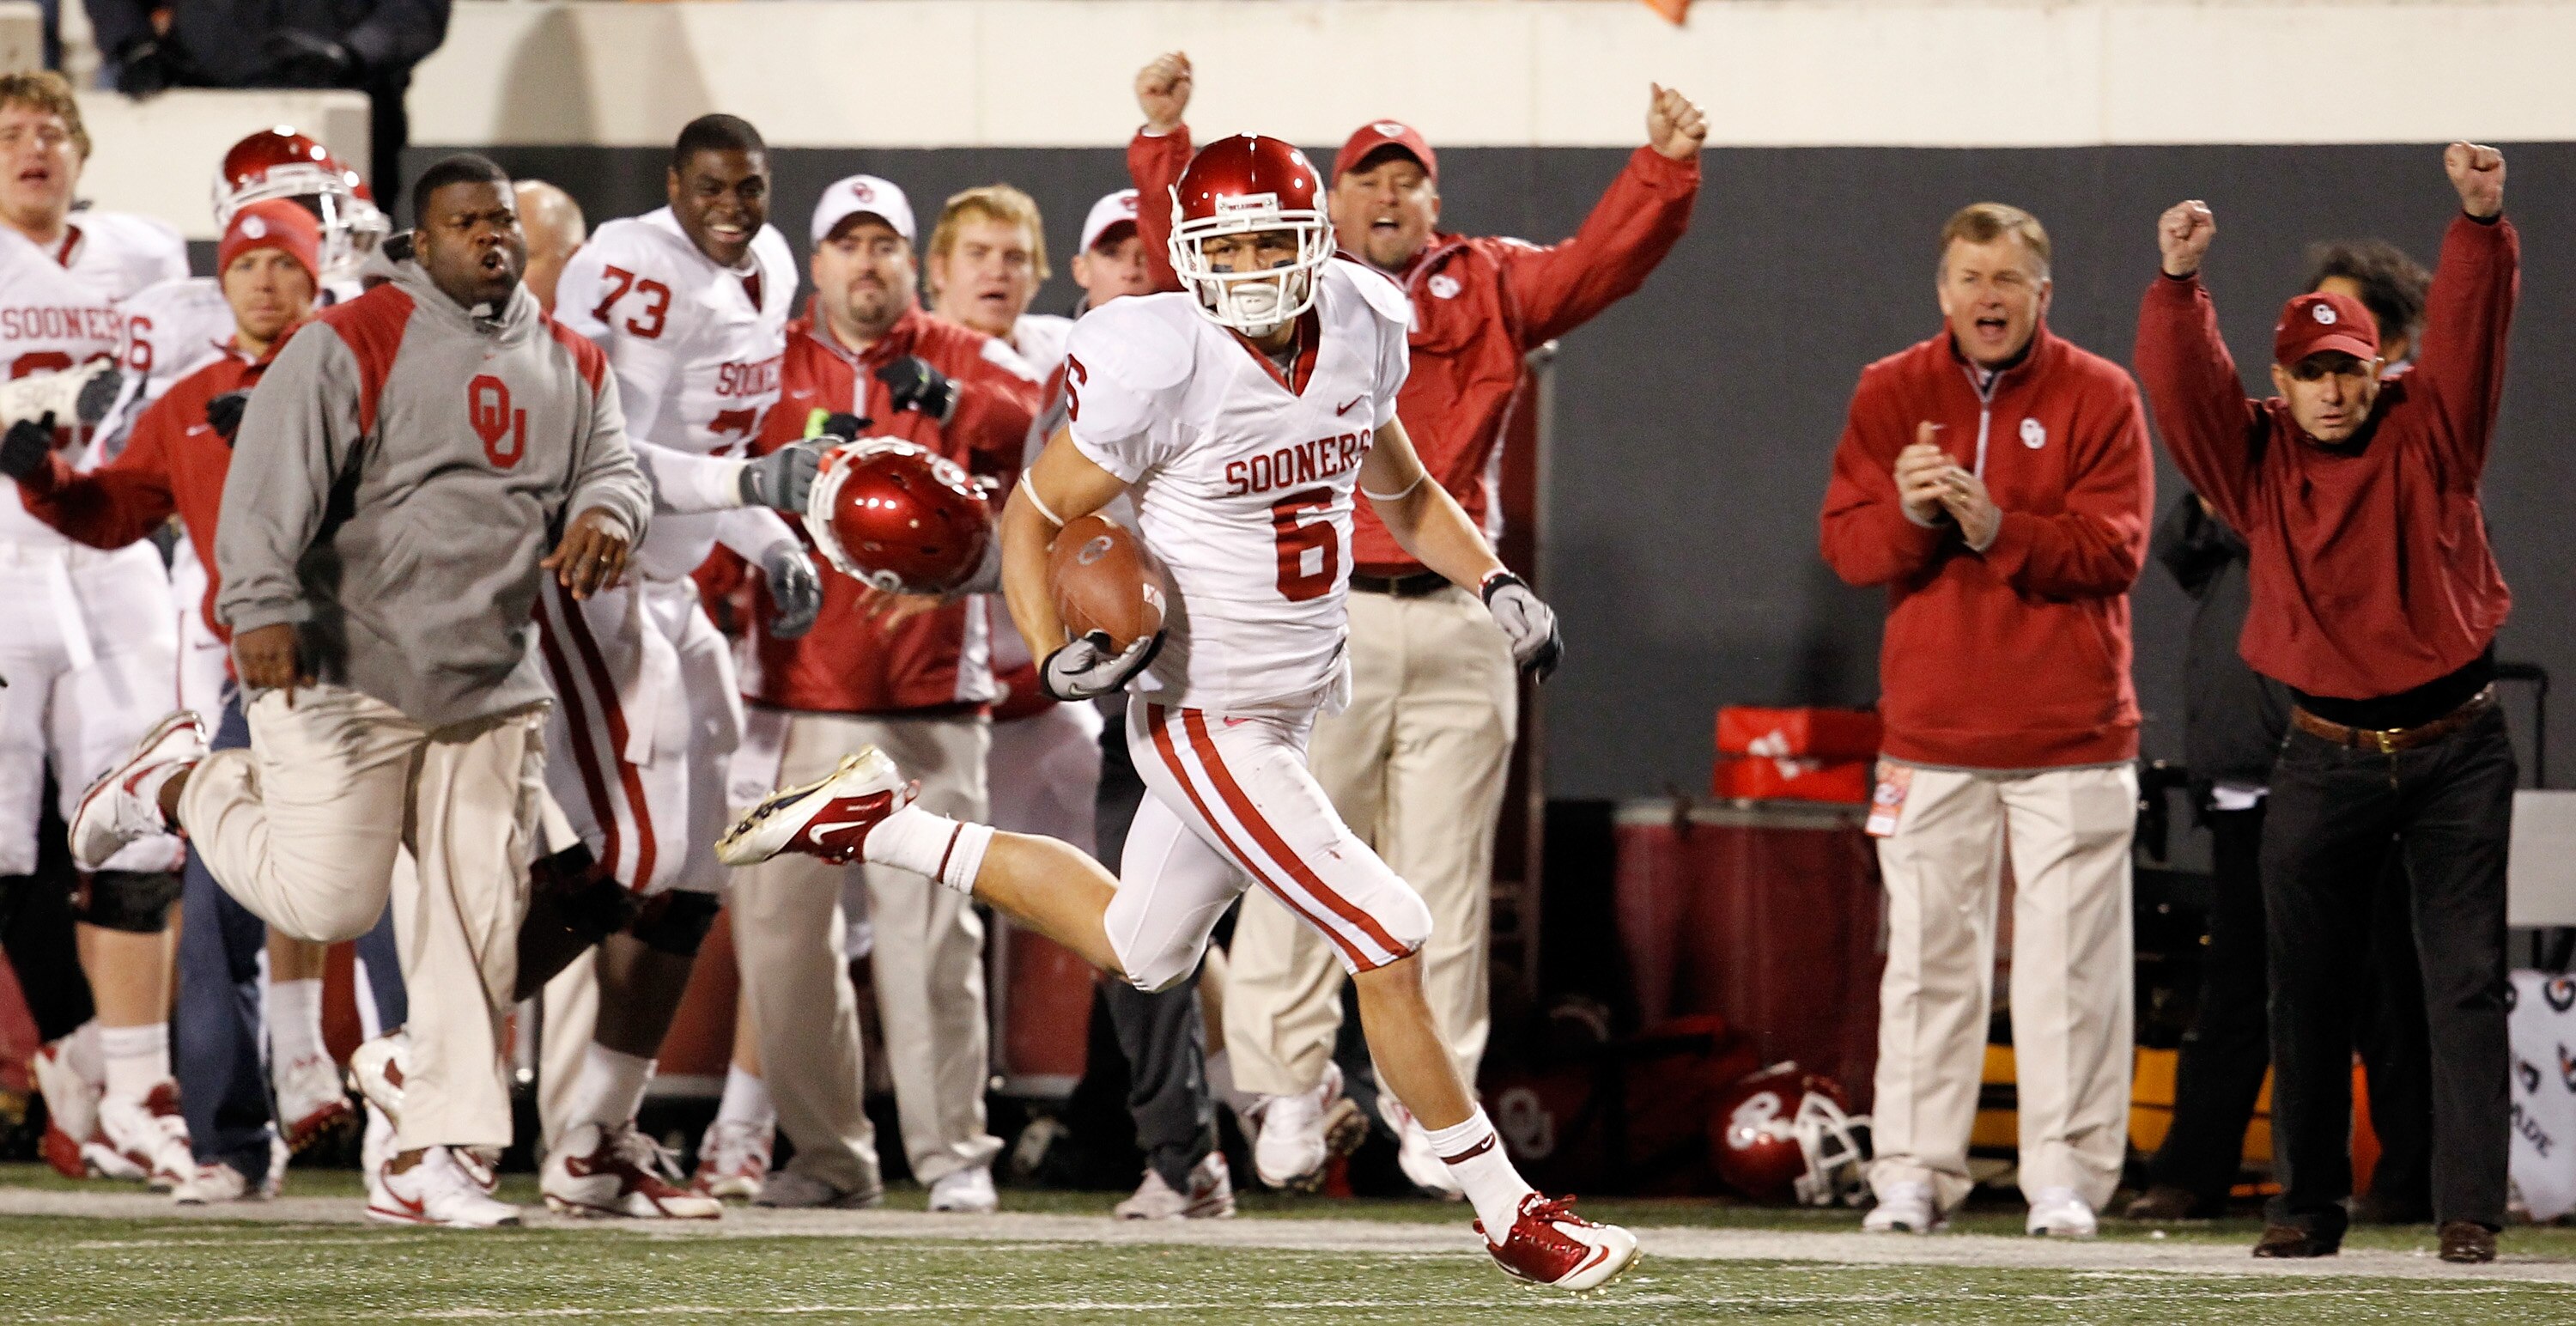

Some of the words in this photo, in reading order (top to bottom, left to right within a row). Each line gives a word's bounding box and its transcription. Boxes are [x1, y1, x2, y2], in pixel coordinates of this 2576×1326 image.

[592, 265, 671, 339] 73
[468, 374, 526, 469] OU
[1065, 353, 1088, 422] 6
[1225, 429, 1371, 496] SOONERS
[1272, 486, 1338, 602] 6
